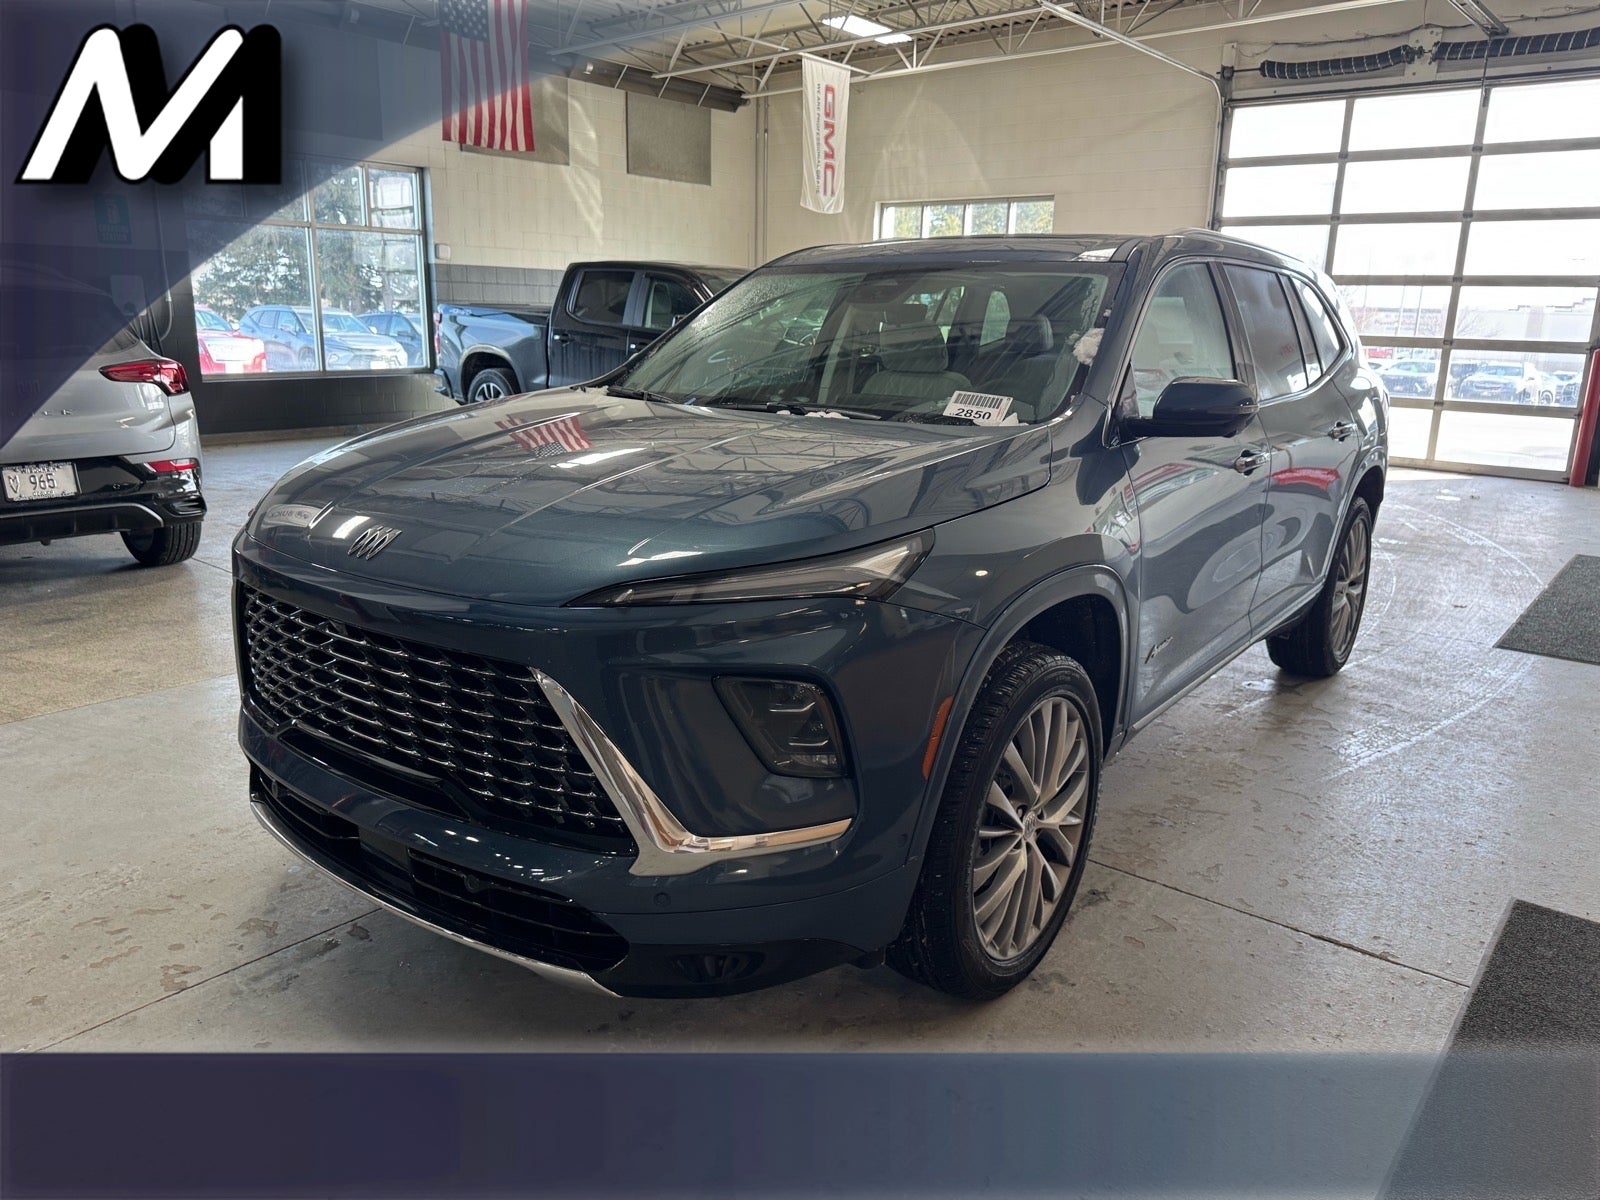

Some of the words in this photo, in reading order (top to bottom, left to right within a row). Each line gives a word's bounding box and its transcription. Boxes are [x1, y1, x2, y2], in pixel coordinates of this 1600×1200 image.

[824, 84, 835, 197] GMC
[955, 407, 992, 420] 2850
[29, 472, 56, 491] 965
